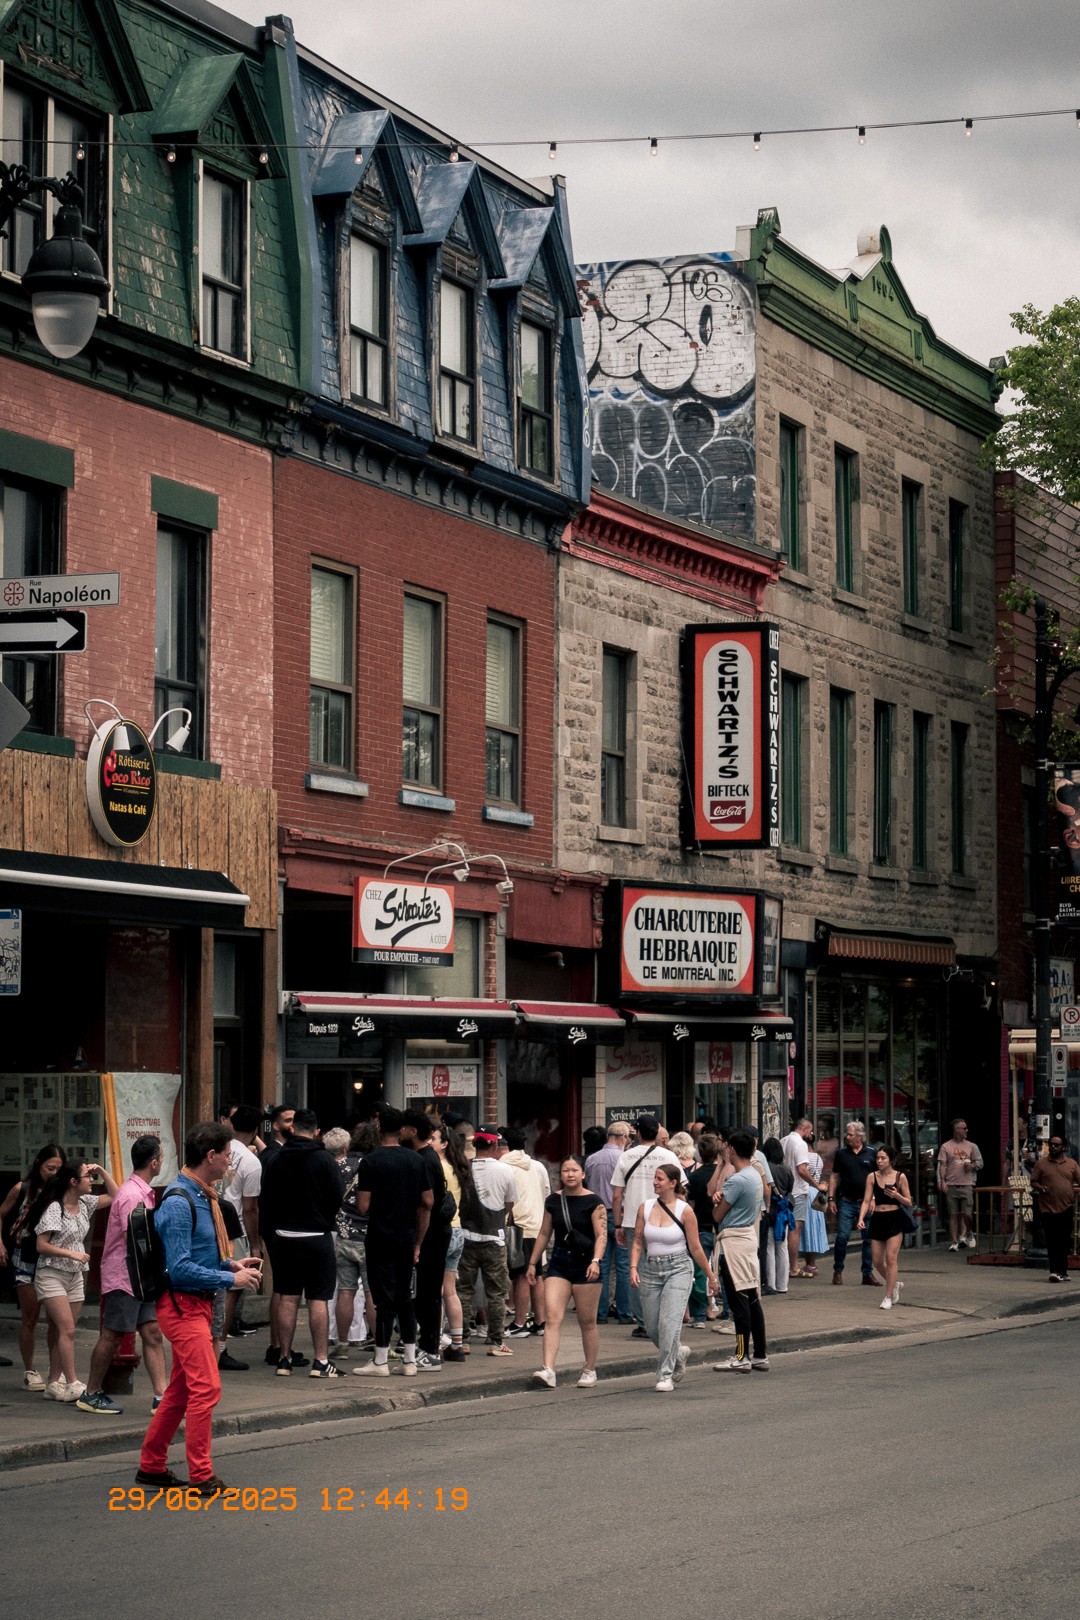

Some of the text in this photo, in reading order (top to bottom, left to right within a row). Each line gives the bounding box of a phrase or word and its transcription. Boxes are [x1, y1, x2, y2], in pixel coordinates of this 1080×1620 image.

[29, 585, 111, 606] Napoléon
[717, 649, 740, 779] SCHWARTZ'S
[118, 755, 150, 770] Rôtisserie
[130, 770, 151, 787] Rico
[708, 784, 750, 797] BIFTECK
[110, 801, 147, 815] Natas & Café
[365, 889, 382, 900] CHEZ
[634, 907, 742, 935] CHARCUTERIE
[374, 951, 389, 961] POUR
[390, 952, 418, 963] EMPORTER
[639, 938, 737, 967] HEBRAIQUE
[643, 966, 736, 982] DE MONTRÉAL INC.
[309, 1023, 327, 1035] Depuis
[711, 1051, 723, 1073] 93
[433, 1076, 443, 1090] 93
[127, 1118, 160, 1126] OUVERTURE
[610, 1109, 628, 1121] Service
[629, 1109, 635, 1120] de
